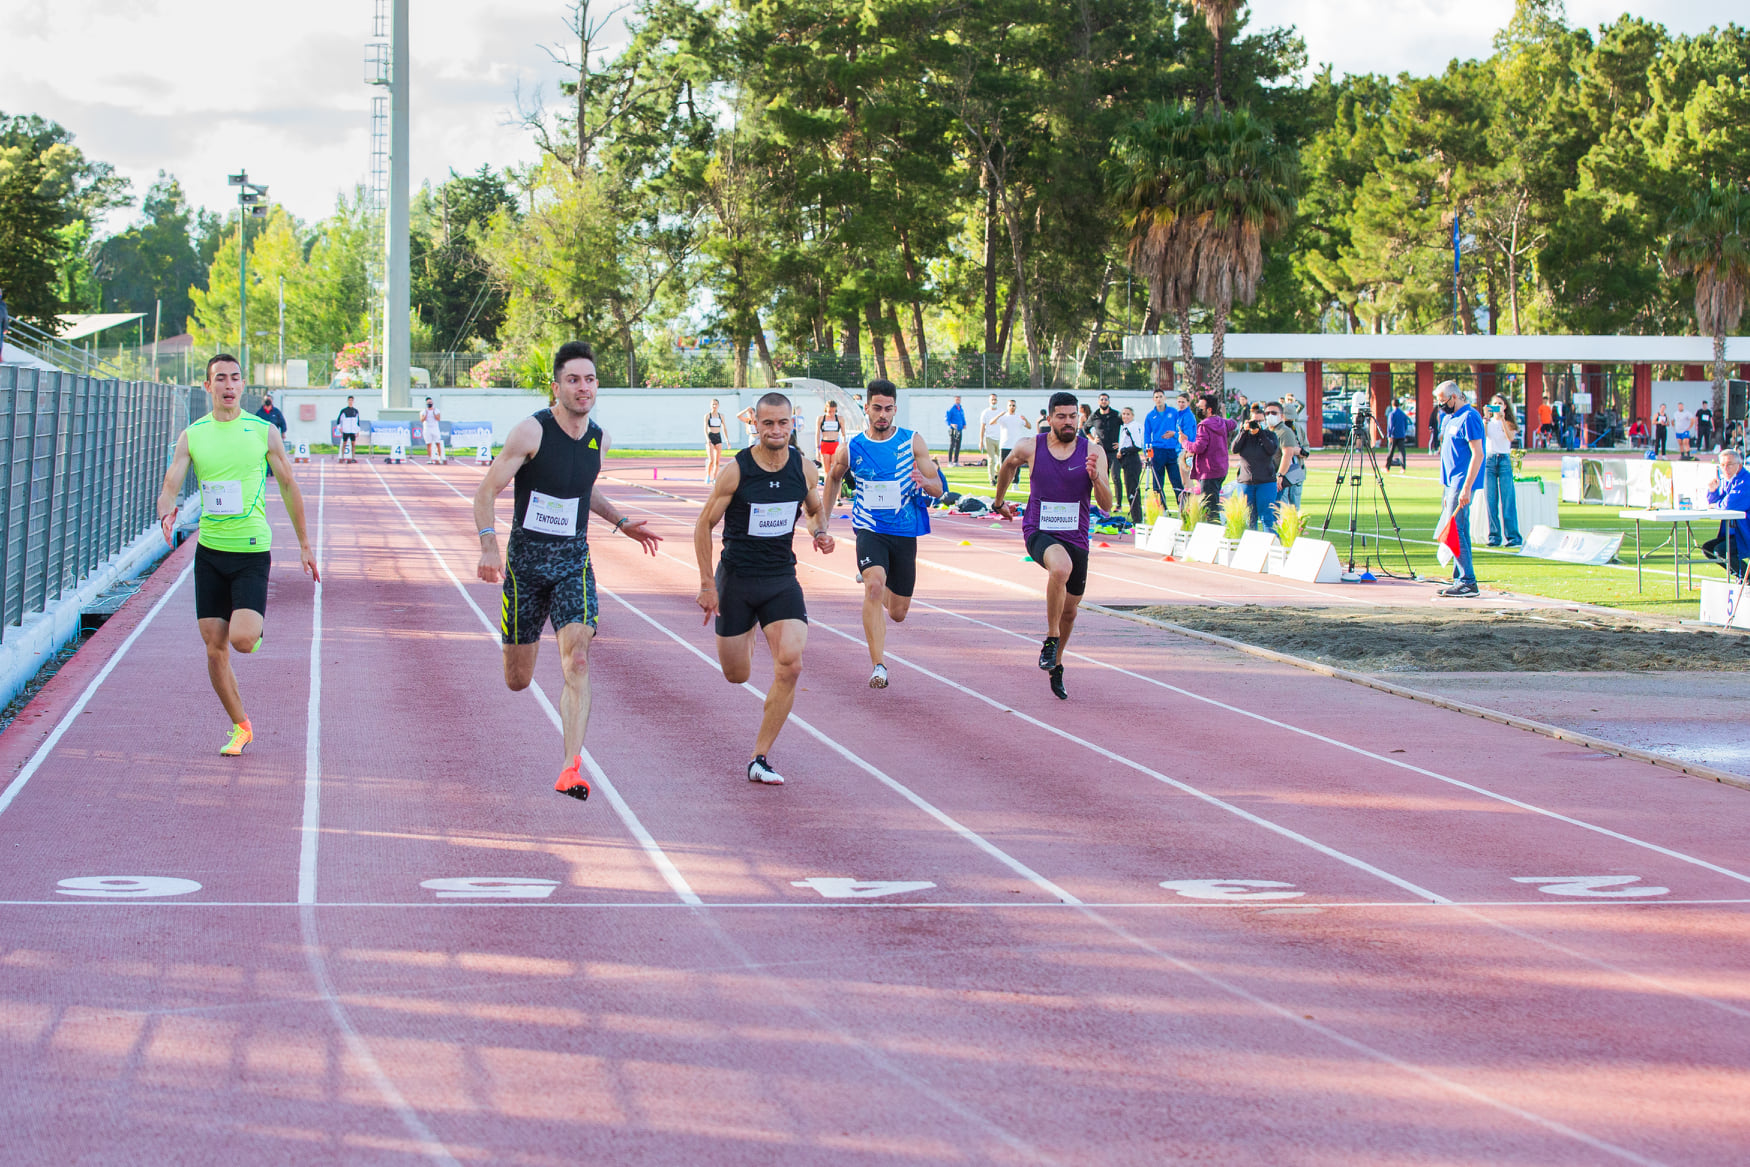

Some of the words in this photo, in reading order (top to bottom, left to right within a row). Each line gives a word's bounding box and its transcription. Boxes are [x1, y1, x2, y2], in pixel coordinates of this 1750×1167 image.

[481, 446, 488, 456] 2
[878, 495, 883, 503] 71
[536, 512, 569, 526] TENTOGLOU
[759, 519, 787, 528] GARAGANIS
[1041, 515, 1073, 523] PAPADOPOULOS
[1727, 590, 1734, 616] 5
[420, 877, 560, 899] 5
[1159, 879, 1306, 900] 3
[1510, 876, 1671, 898] 2
